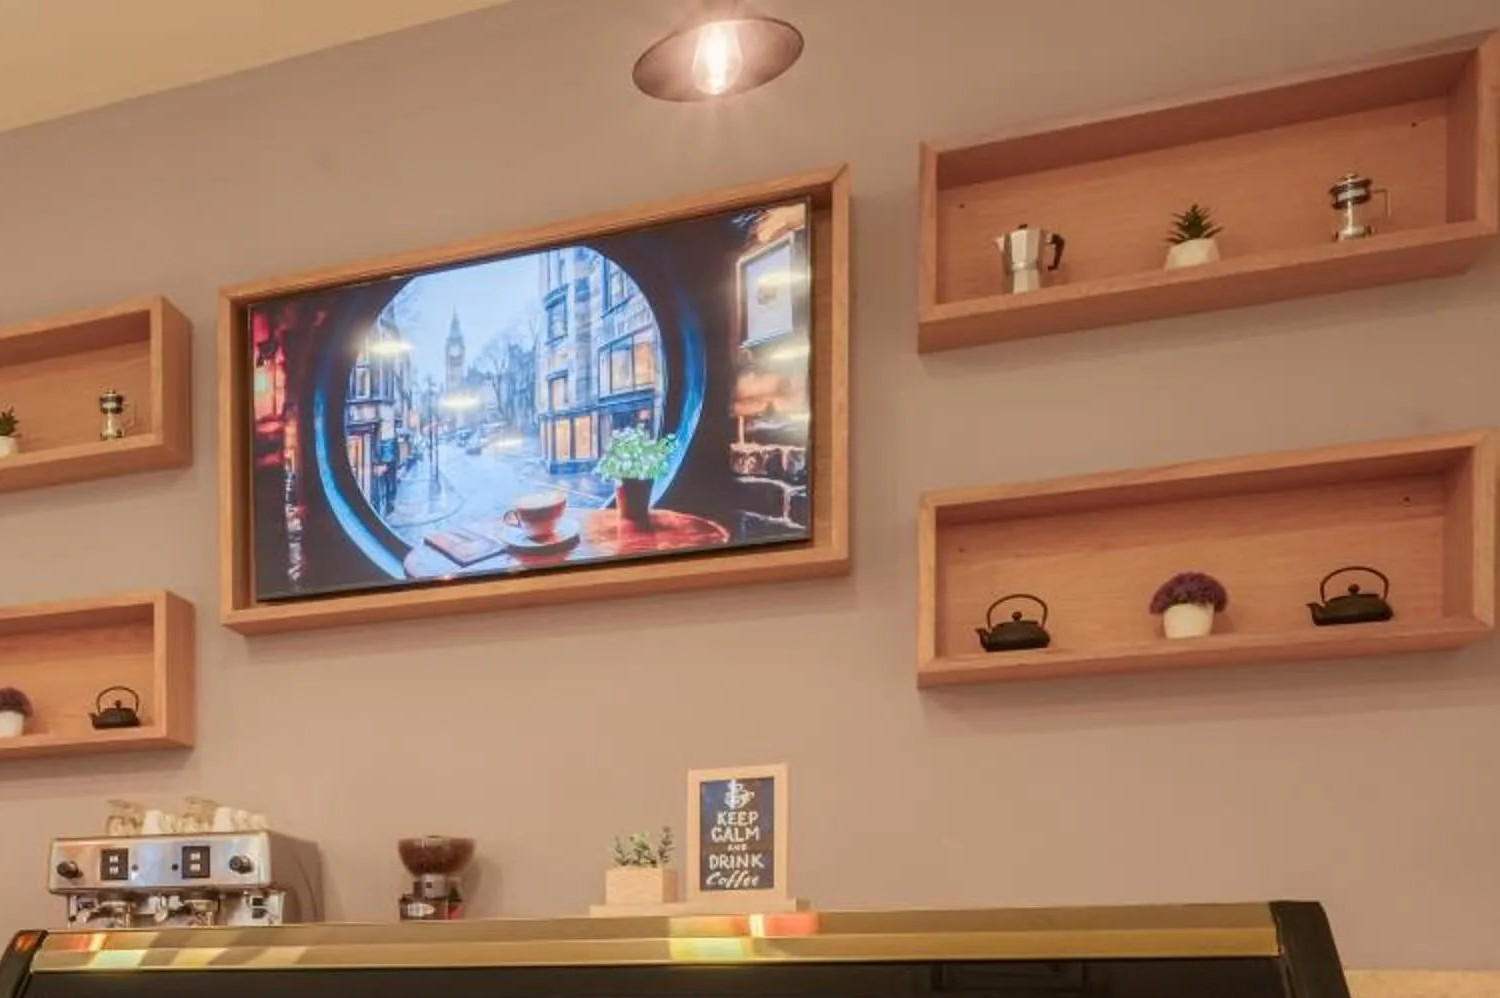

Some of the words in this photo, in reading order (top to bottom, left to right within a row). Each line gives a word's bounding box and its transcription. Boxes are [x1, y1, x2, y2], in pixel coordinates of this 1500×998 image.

[717, 811, 758, 826] KEEP
[711, 827, 760, 842] CALM
[709, 853, 764, 869] DRINK
[706, 870, 759, 888] Coffee
